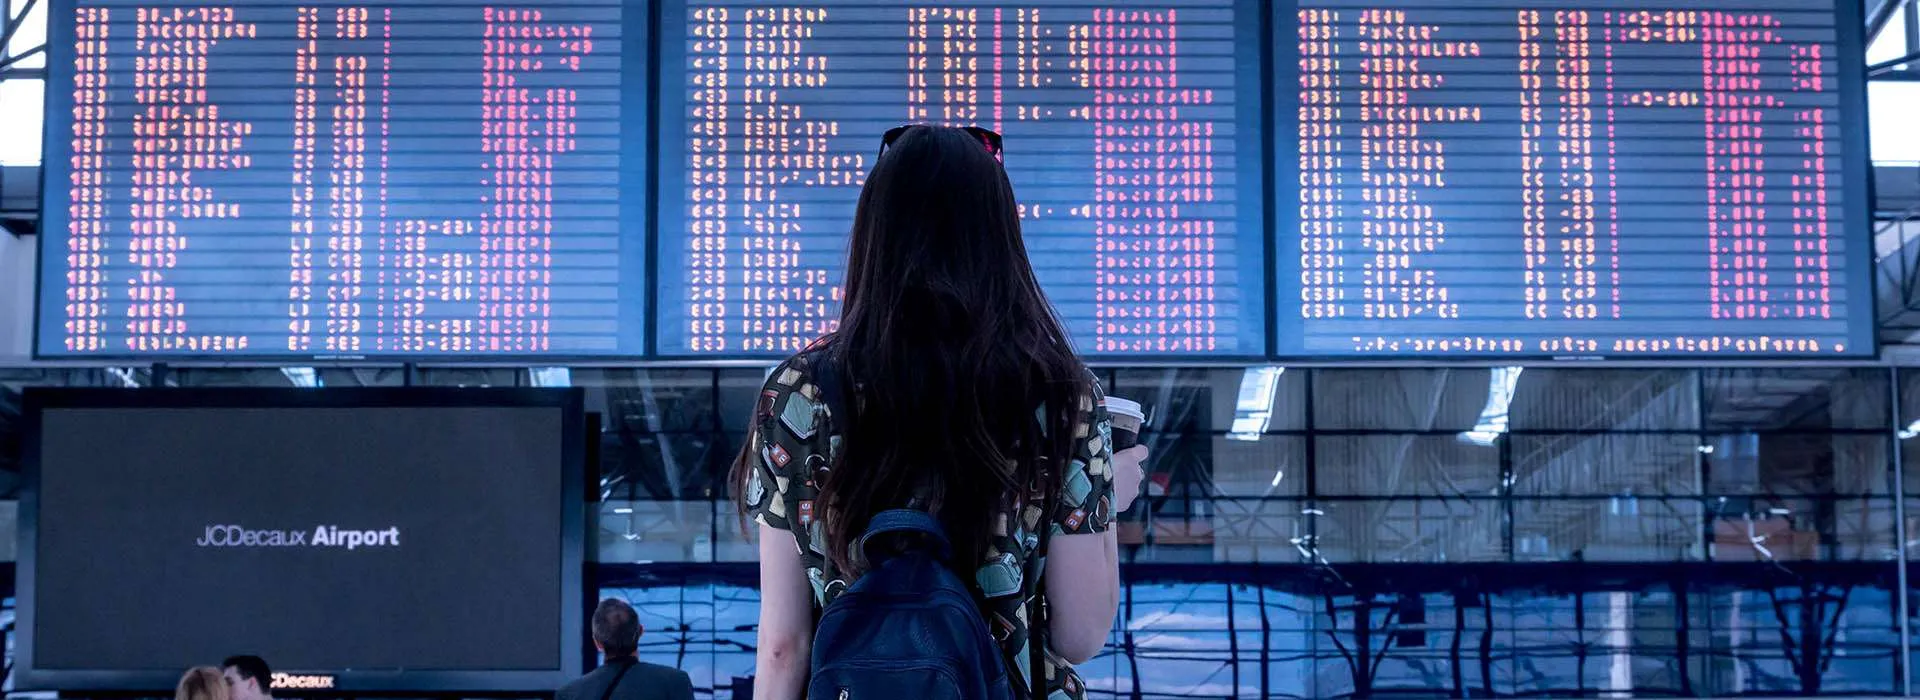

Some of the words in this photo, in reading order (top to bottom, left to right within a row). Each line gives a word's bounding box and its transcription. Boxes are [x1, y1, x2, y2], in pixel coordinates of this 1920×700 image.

[197, 524, 306, 546] JCDecaux
[311, 525, 400, 550] Airport
[270, 672, 335, 688] CDecaux
